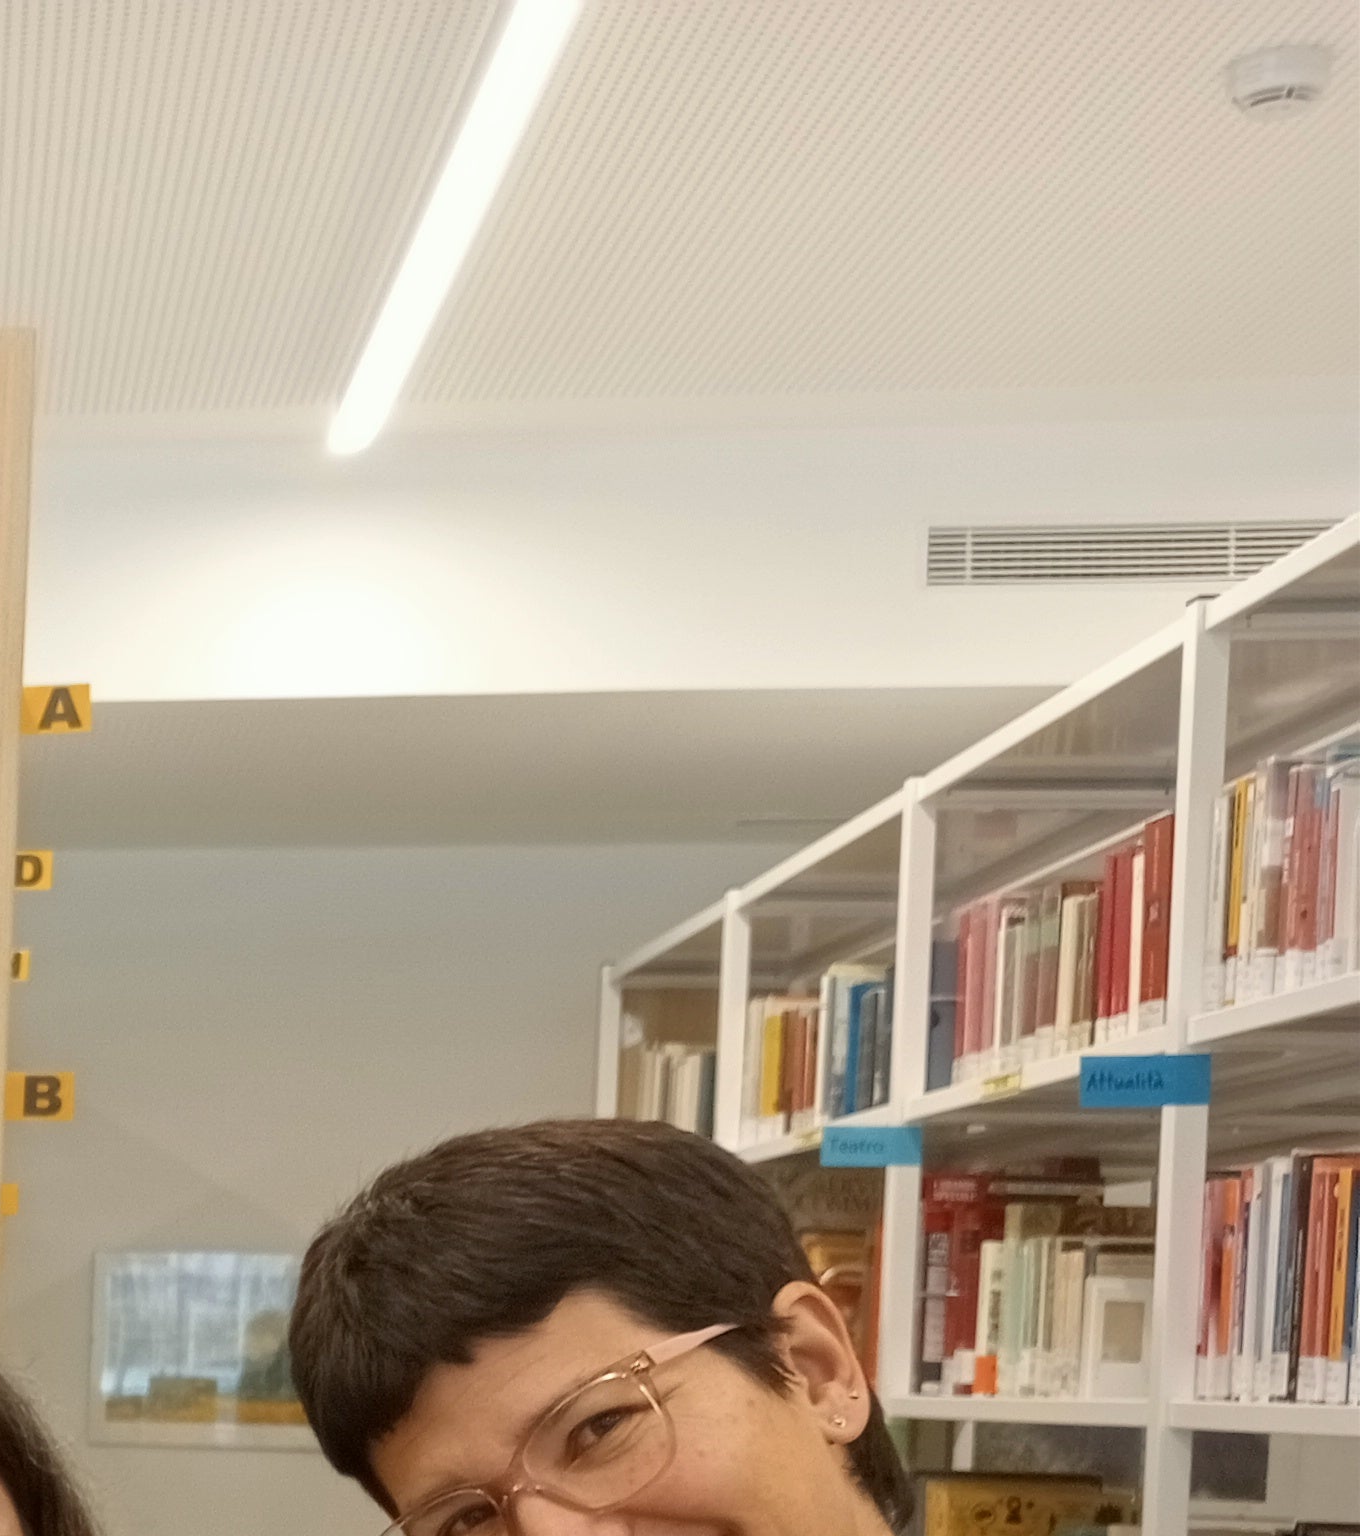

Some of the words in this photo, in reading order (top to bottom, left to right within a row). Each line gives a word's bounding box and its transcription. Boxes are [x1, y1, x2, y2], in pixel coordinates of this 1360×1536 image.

[37, 686, 82, 731] A
[14, 854, 43, 888] D
[22, 1074, 63, 1118] B
